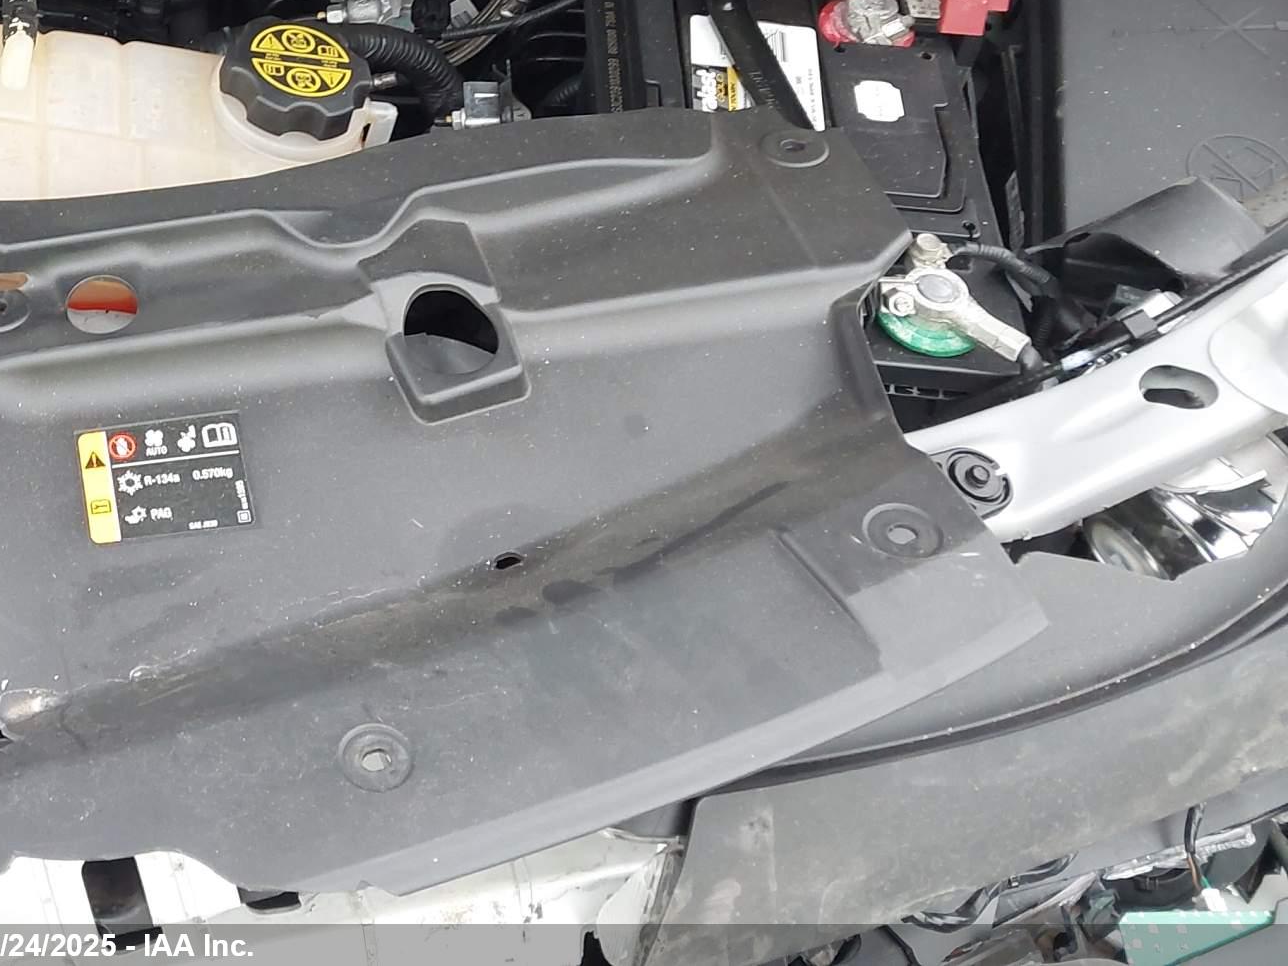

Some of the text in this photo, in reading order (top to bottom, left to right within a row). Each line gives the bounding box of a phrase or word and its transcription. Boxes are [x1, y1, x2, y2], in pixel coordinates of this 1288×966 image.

[145, 445, 168, 457] AUTO
[143, 466, 234, 487] R-134a 0.570kg
[149, 507, 173, 520] PAG
